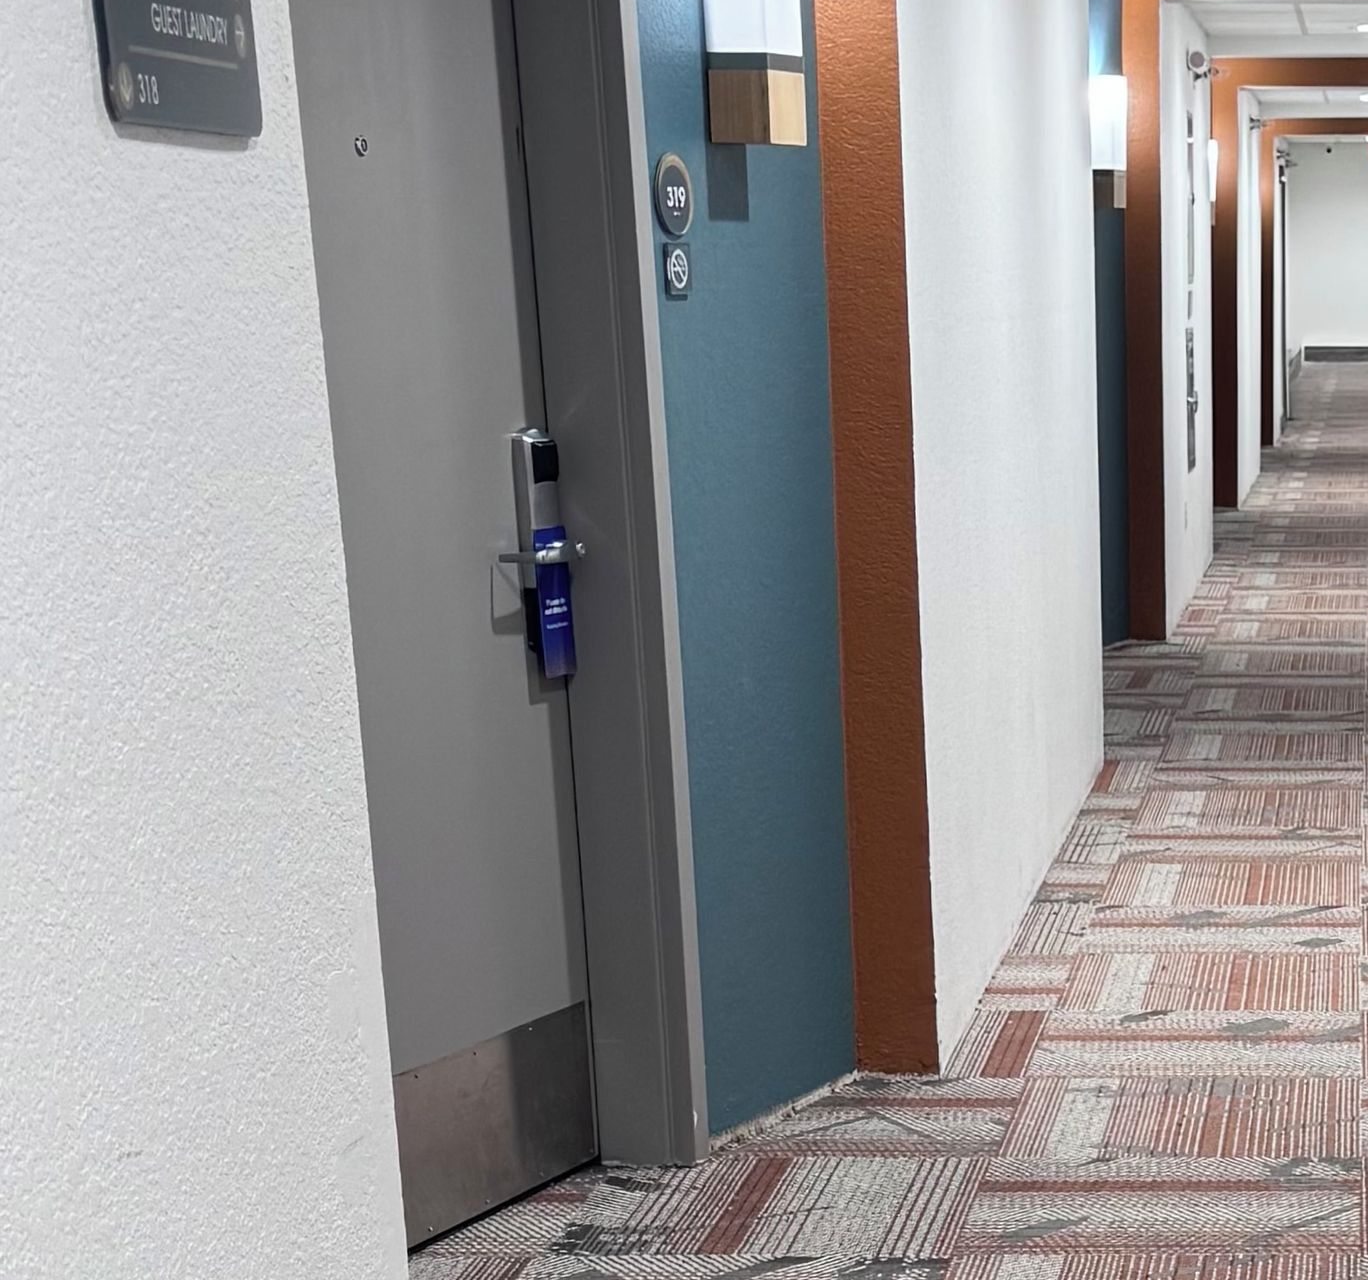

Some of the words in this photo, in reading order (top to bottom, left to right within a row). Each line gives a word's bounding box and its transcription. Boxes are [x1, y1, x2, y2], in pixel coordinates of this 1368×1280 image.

[151, 2, 183, 38] GUEST
[183, 8, 228, 46] LAUNDRY
[137, 73, 160, 105] 318
[666, 186, 686, 208] 319
